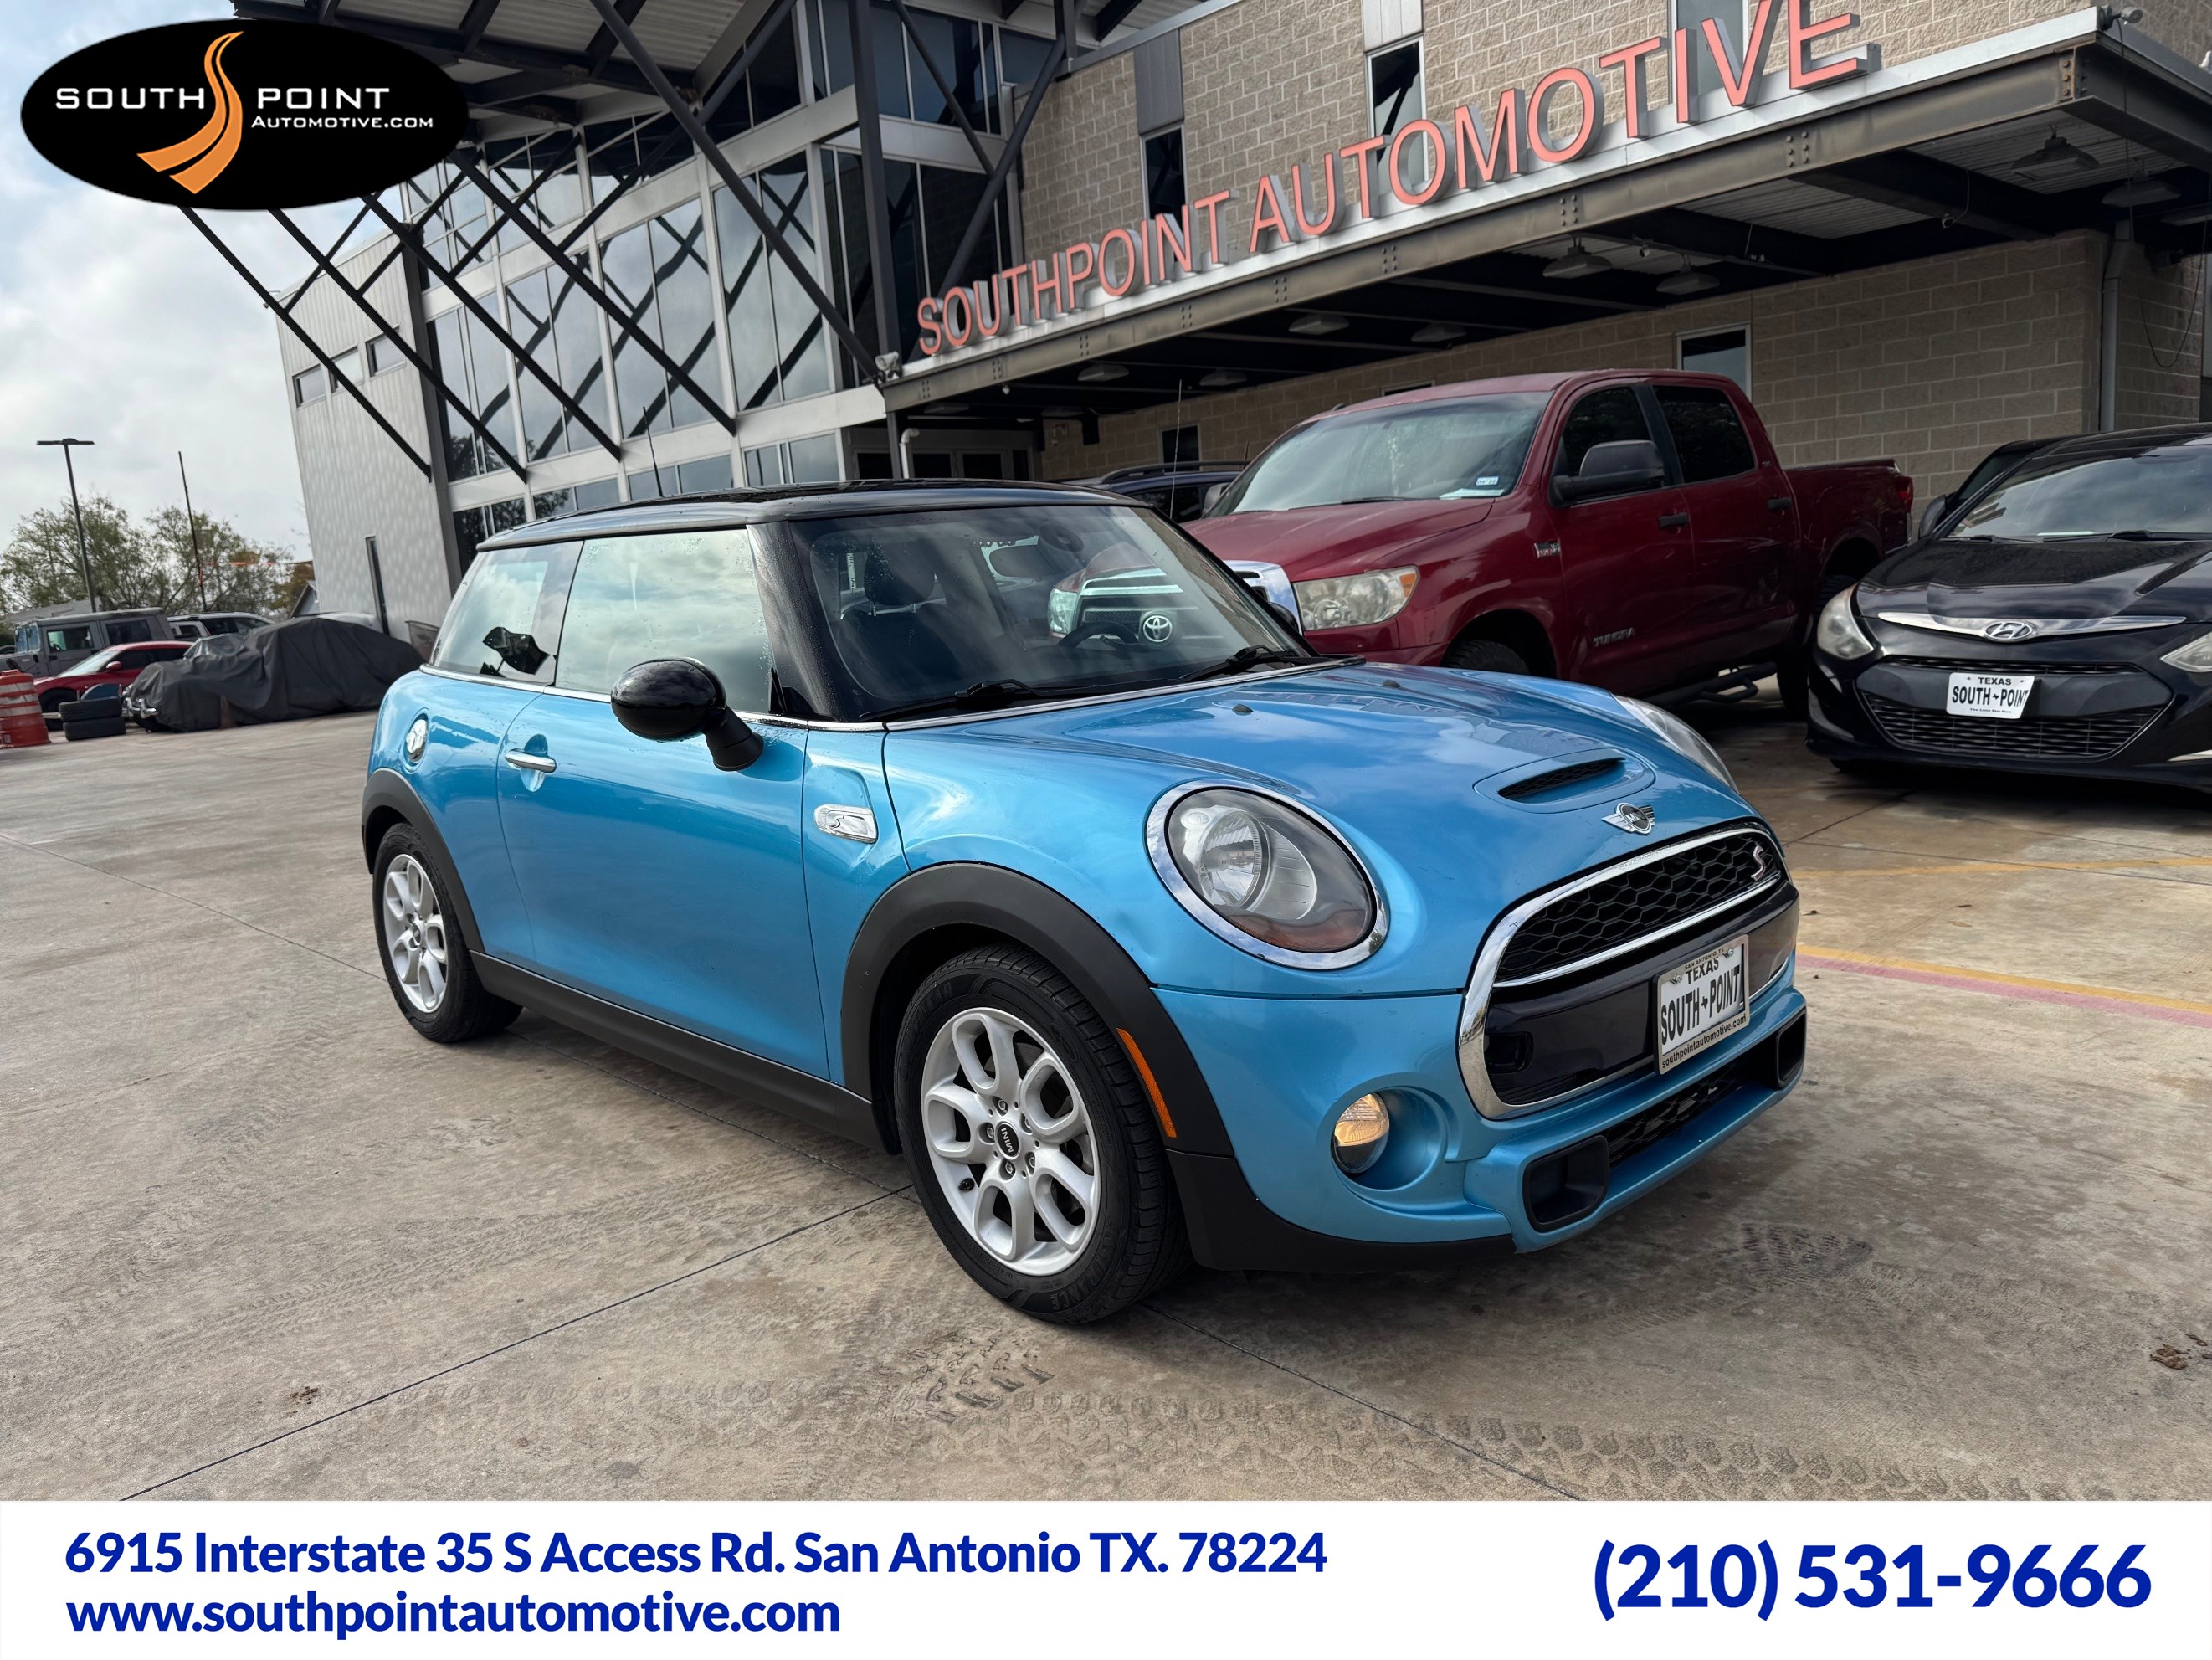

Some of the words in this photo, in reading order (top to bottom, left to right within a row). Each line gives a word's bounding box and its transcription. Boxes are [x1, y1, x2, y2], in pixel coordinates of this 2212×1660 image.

[917, 189, 1237, 356] SOUTHPOINT
[1250, 0, 1860, 253] AUTOMOTIVE
[1978, 676, 2012, 686] TEXAS
[1952, 686, 1991, 706] SOUTH
[1999, 688, 2029, 707] POINT
[1686, 955, 1719, 984] TEXAS
[1660, 987, 1700, 1046] SOUTH
[1709, 964, 1741, 1019] POINT
[1662, 1013, 1747, 1069] southpointautomotive.com
[1001, 1128, 1014, 1153] MINI
